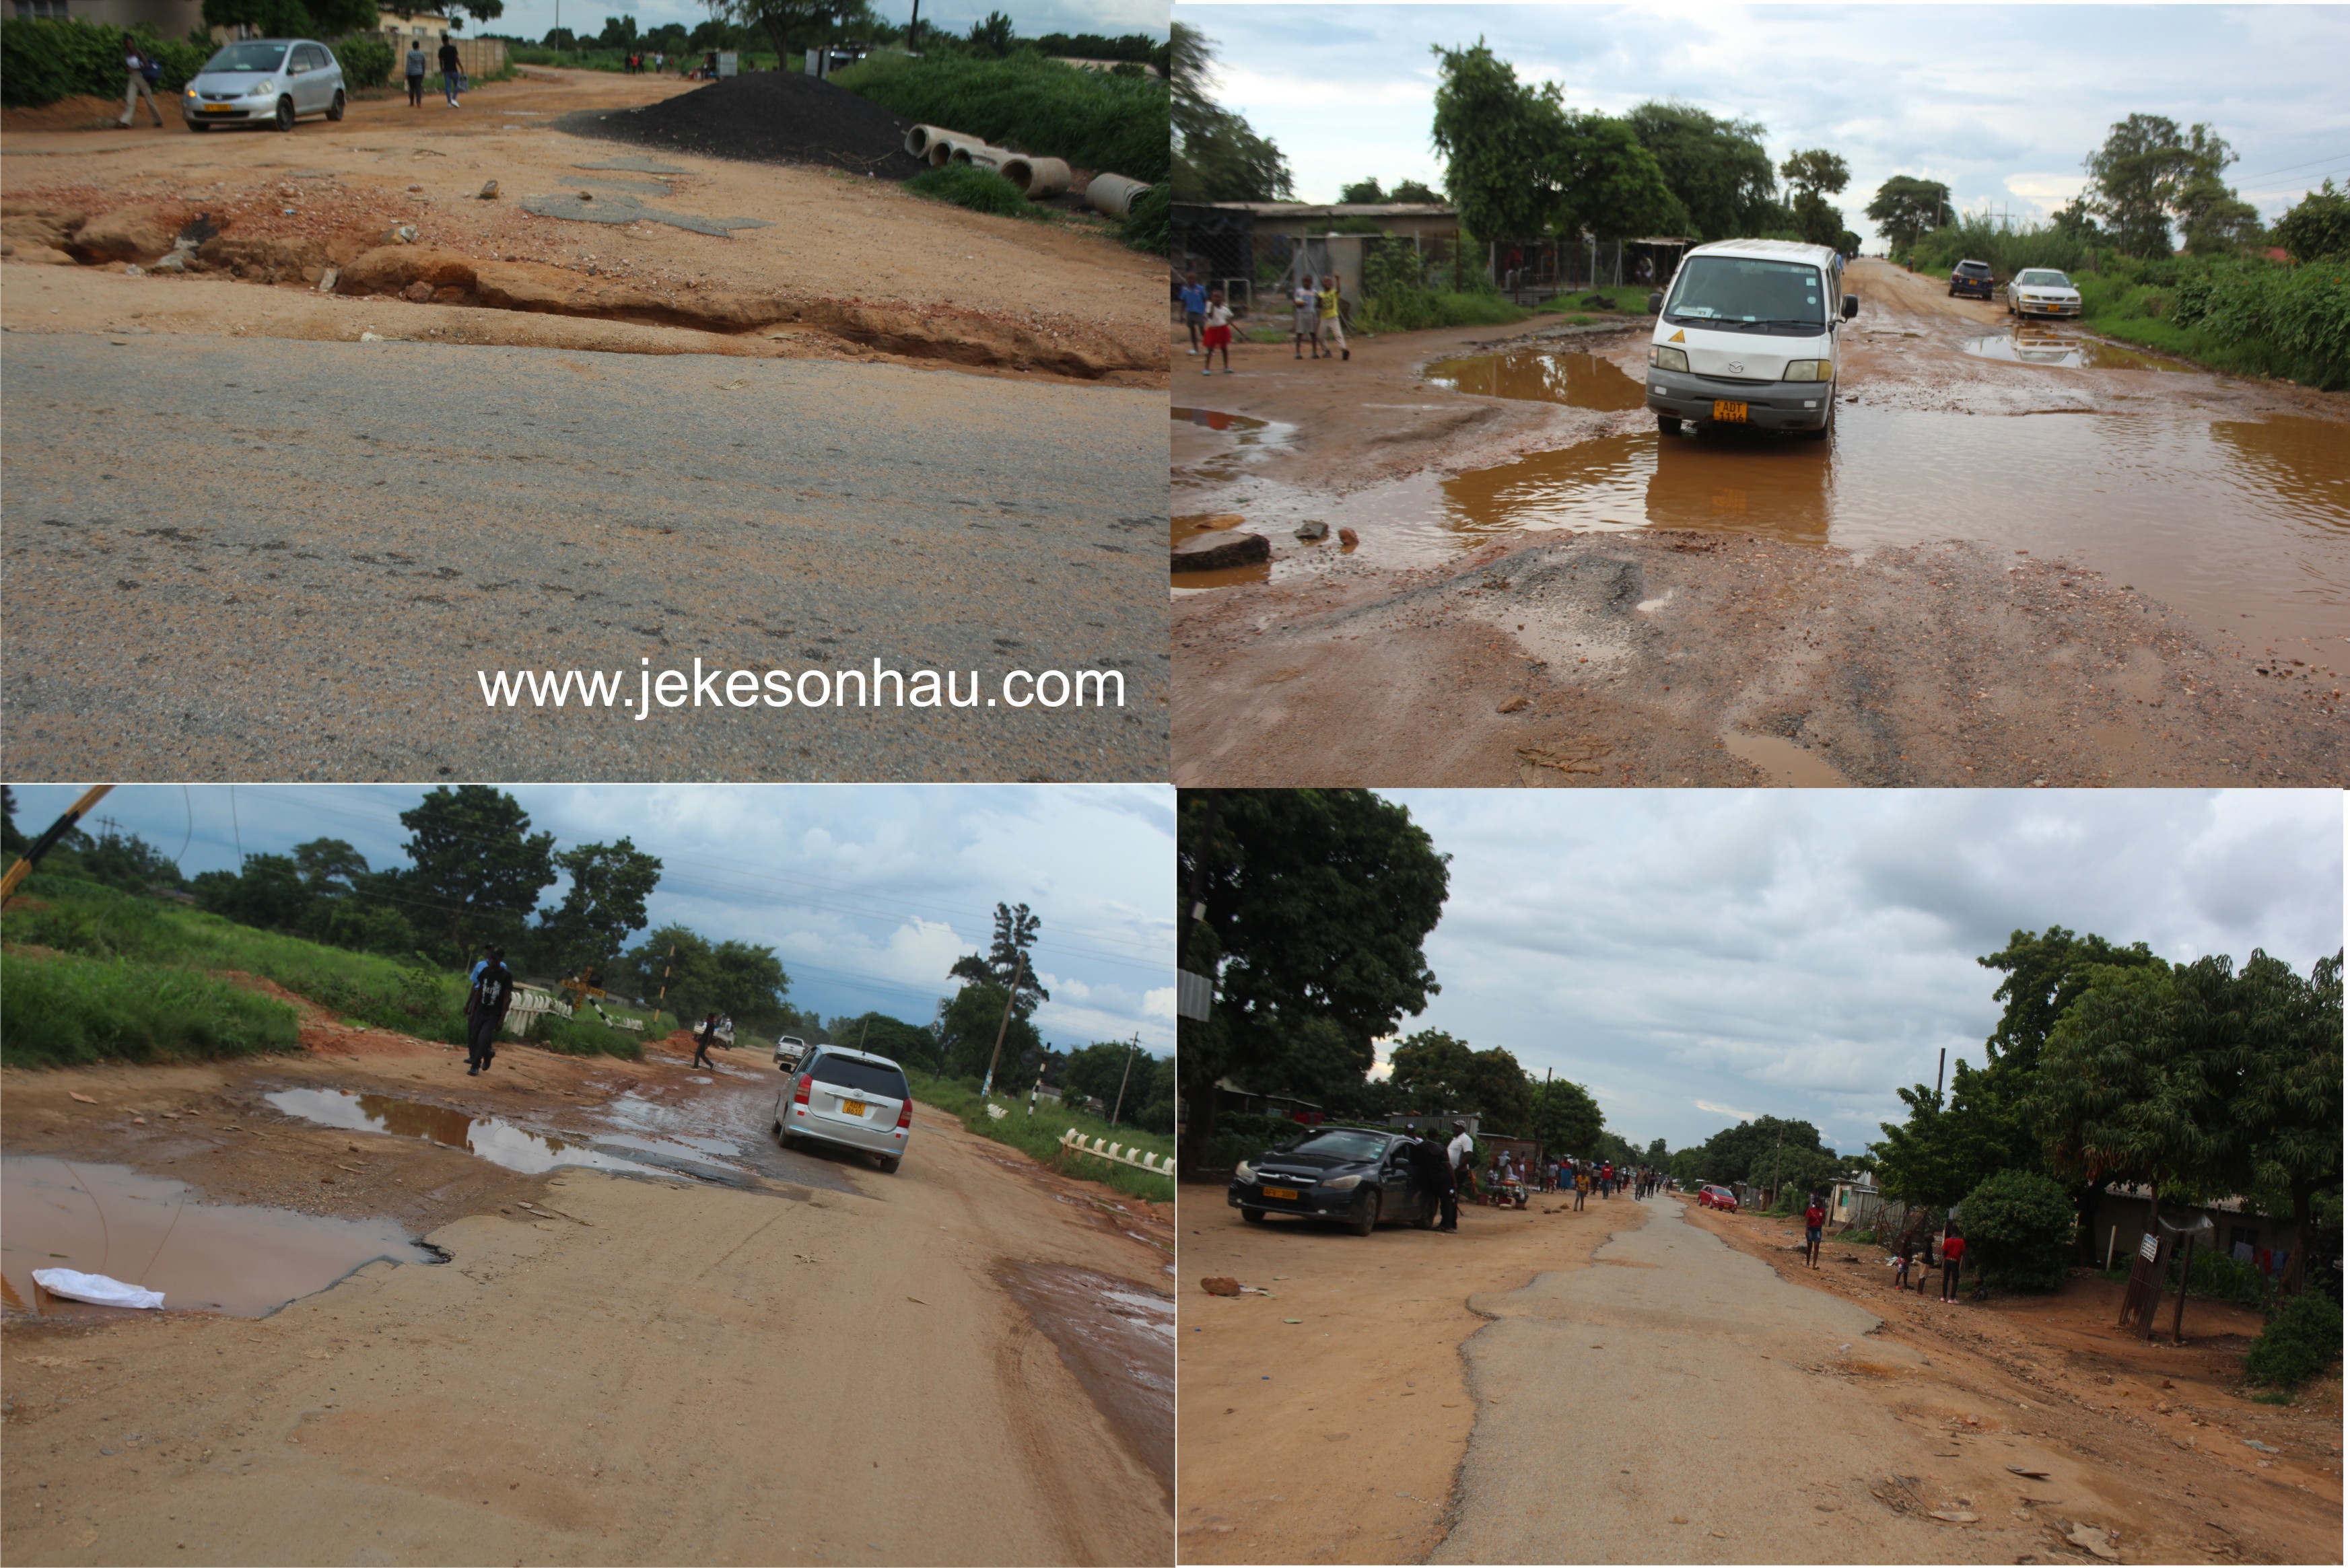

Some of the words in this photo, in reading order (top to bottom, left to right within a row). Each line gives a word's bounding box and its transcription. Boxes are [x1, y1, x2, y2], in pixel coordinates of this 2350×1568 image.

[1723, 402, 1742, 413] ADT
[1719, 412, 1744, 422] 1116
[846, 1107, 862, 1116] 8610
